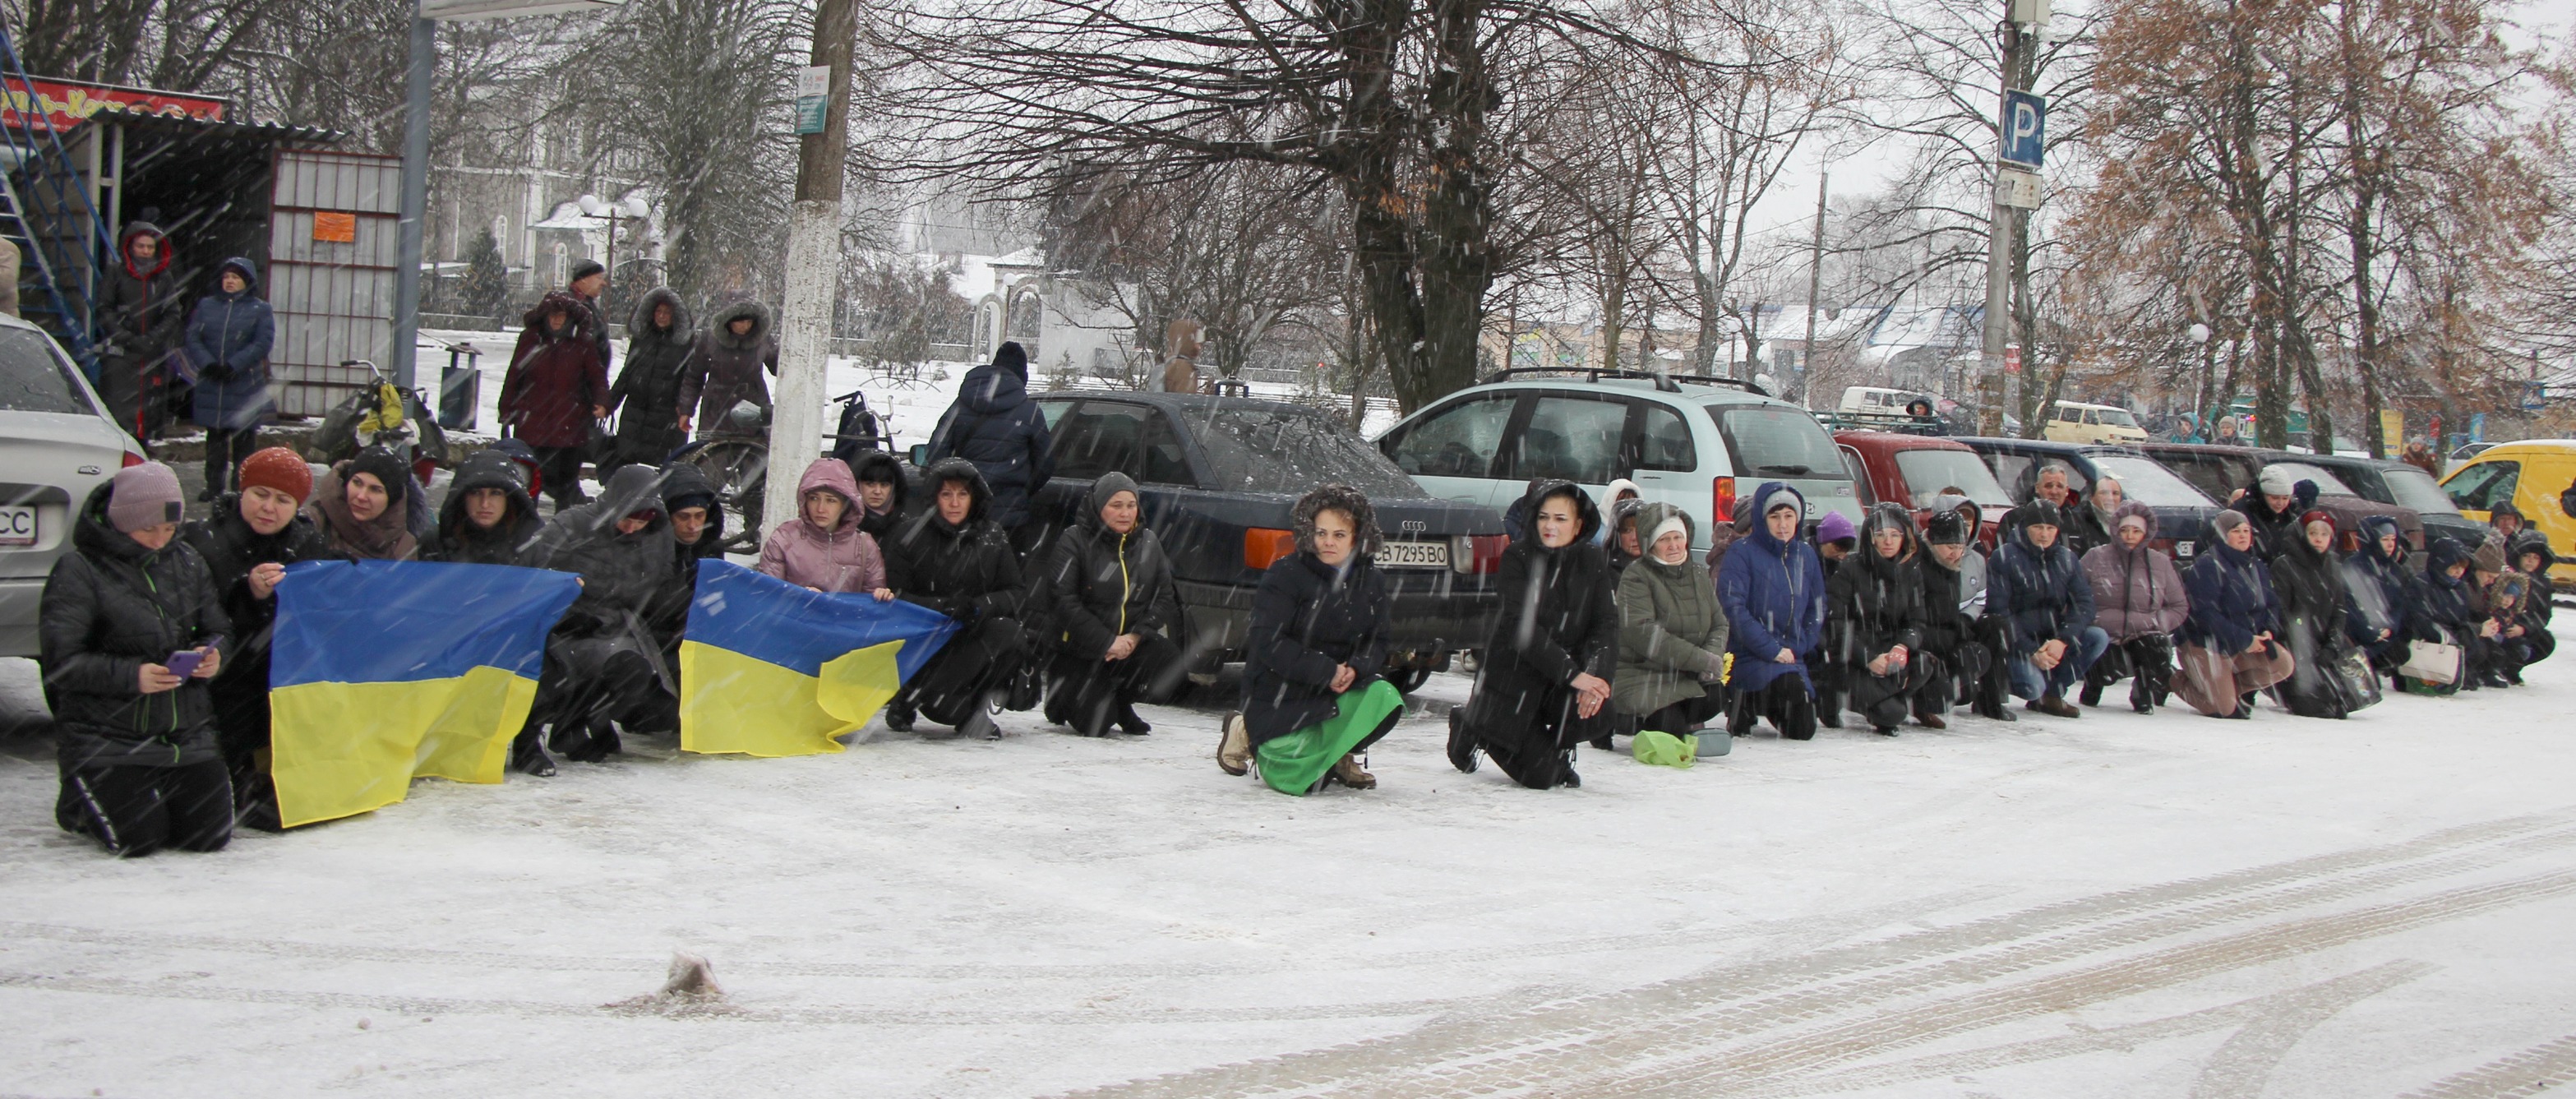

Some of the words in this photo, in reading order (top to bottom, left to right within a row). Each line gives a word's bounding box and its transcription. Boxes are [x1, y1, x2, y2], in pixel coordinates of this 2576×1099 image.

[2012, 101, 2037, 153] P
[1393, 545, 1425, 563] 7295
[1427, 546, 1447, 563] BO
